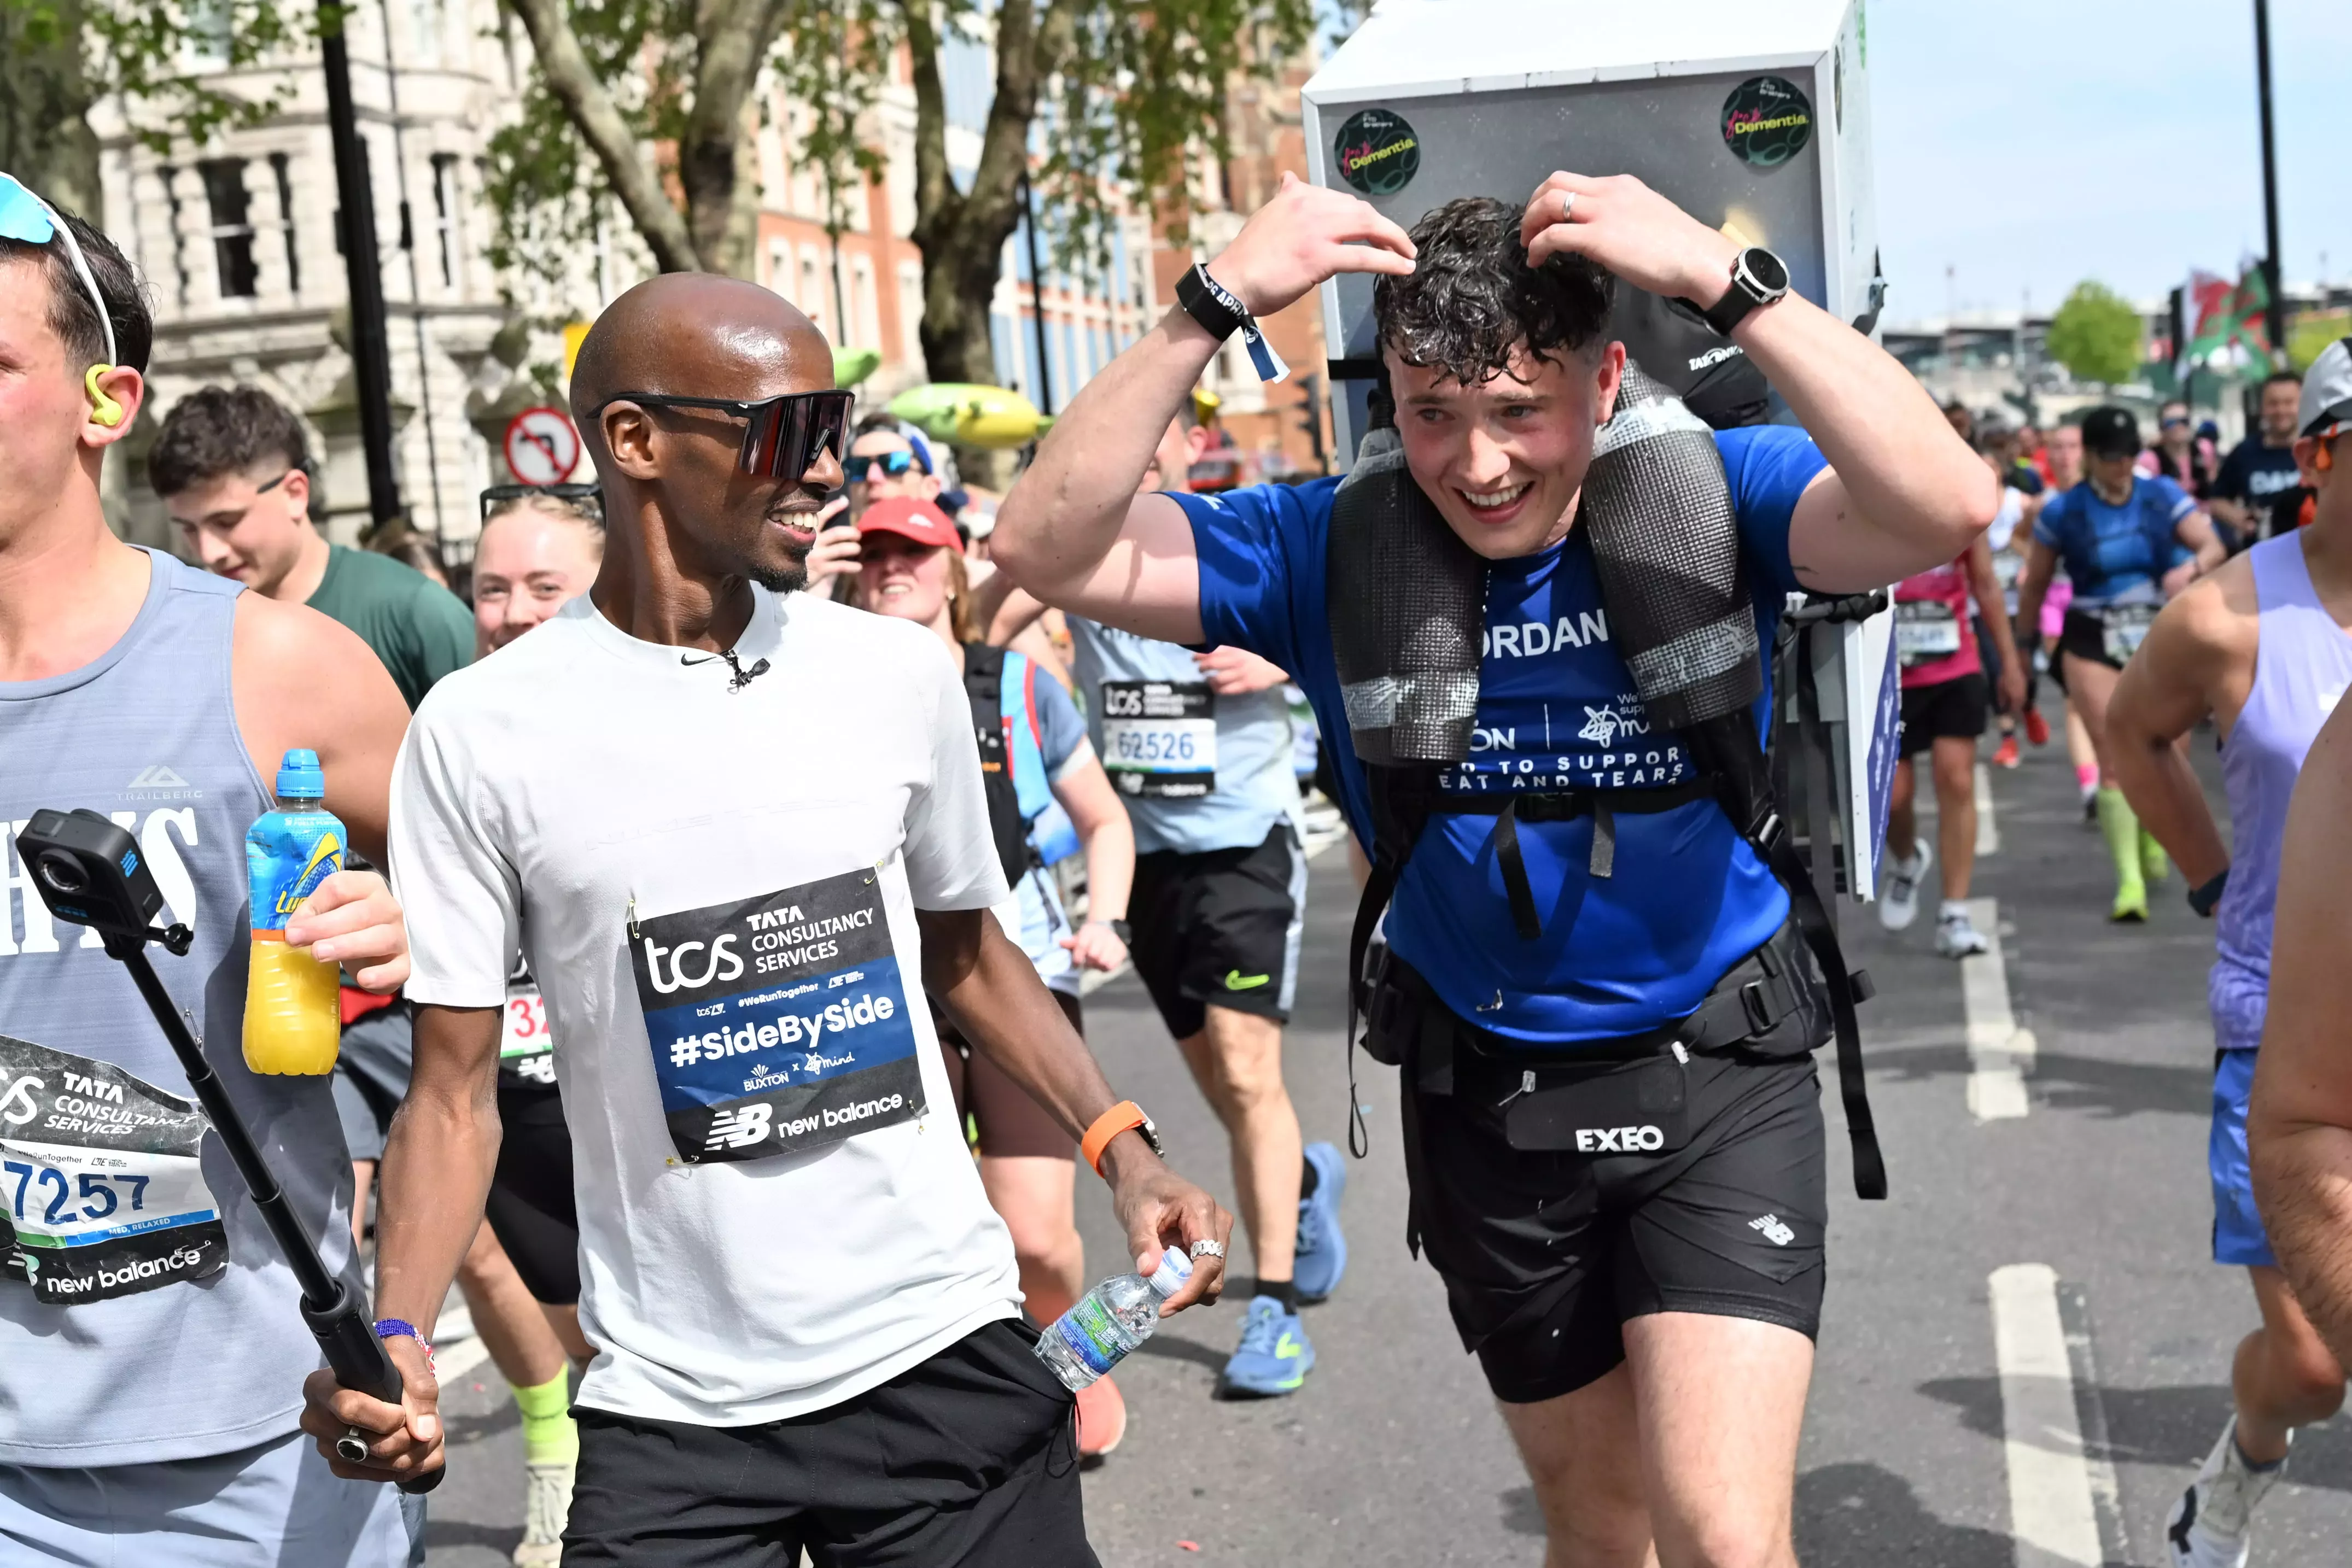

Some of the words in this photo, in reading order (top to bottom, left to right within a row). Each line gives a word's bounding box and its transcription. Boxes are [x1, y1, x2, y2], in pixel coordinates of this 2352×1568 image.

[1118, 732, 1195, 760] 62526
[1499, 760, 1534, 774] TO
[1557, 742, 1689, 772] SUPPOR
[1512, 775, 1569, 788] AND
[1592, 763, 1683, 787] TEARS
[116, 791, 203, 801] TRAILBERG
[751, 908, 873, 952] CONSULTANCY
[644, 933, 744, 993] tcs
[746, 905, 804, 931] TATA
[755, 940, 839, 974] SERVICES
[738, 983, 819, 1008] #WeRunTogether
[670, 994, 894, 1067] #SideBySide
[63, 1071, 123, 1105] TATA
[743, 1072, 790, 1092] BUXTON
[44, 1115, 137, 1135] SERVICES
[55, 1095, 197, 1126] CONSULTANCY
[778, 1113, 819, 1138] new
[823, 1093, 903, 1127] balance
[1575, 1125, 1665, 1152] EXEO
[108, 1225, 131, 1235] MED,
[132, 1218, 171, 1231] RELAXED
[46, 1276, 93, 1294] new
[98, 1249, 201, 1288] balance
